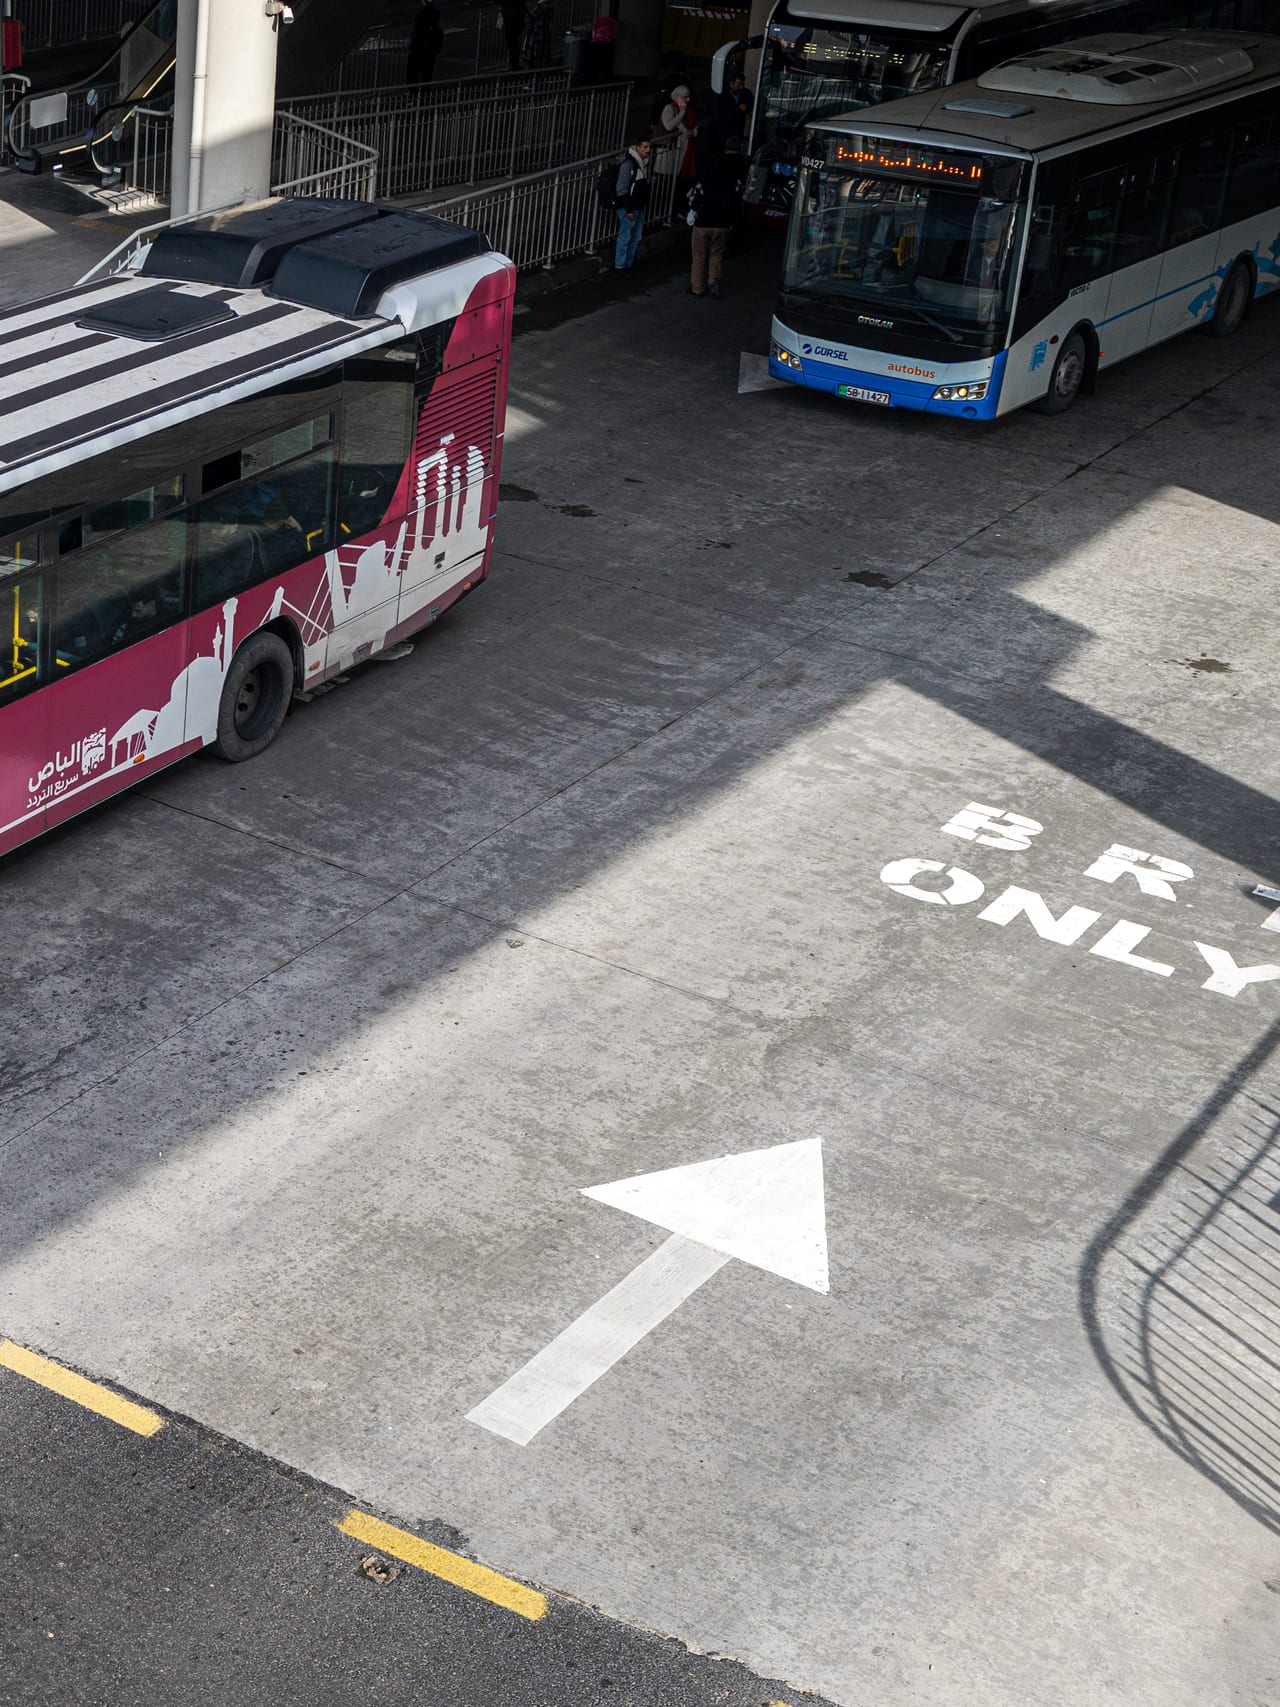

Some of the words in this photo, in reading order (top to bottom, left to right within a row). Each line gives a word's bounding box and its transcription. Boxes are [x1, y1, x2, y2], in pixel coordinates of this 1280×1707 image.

[857, 315, 894, 329] OTOKAR
[887, 361, 936, 379] autobus
[28, 740, 81, 793] الباص
[880, 858, 1280, 998] ONLY
